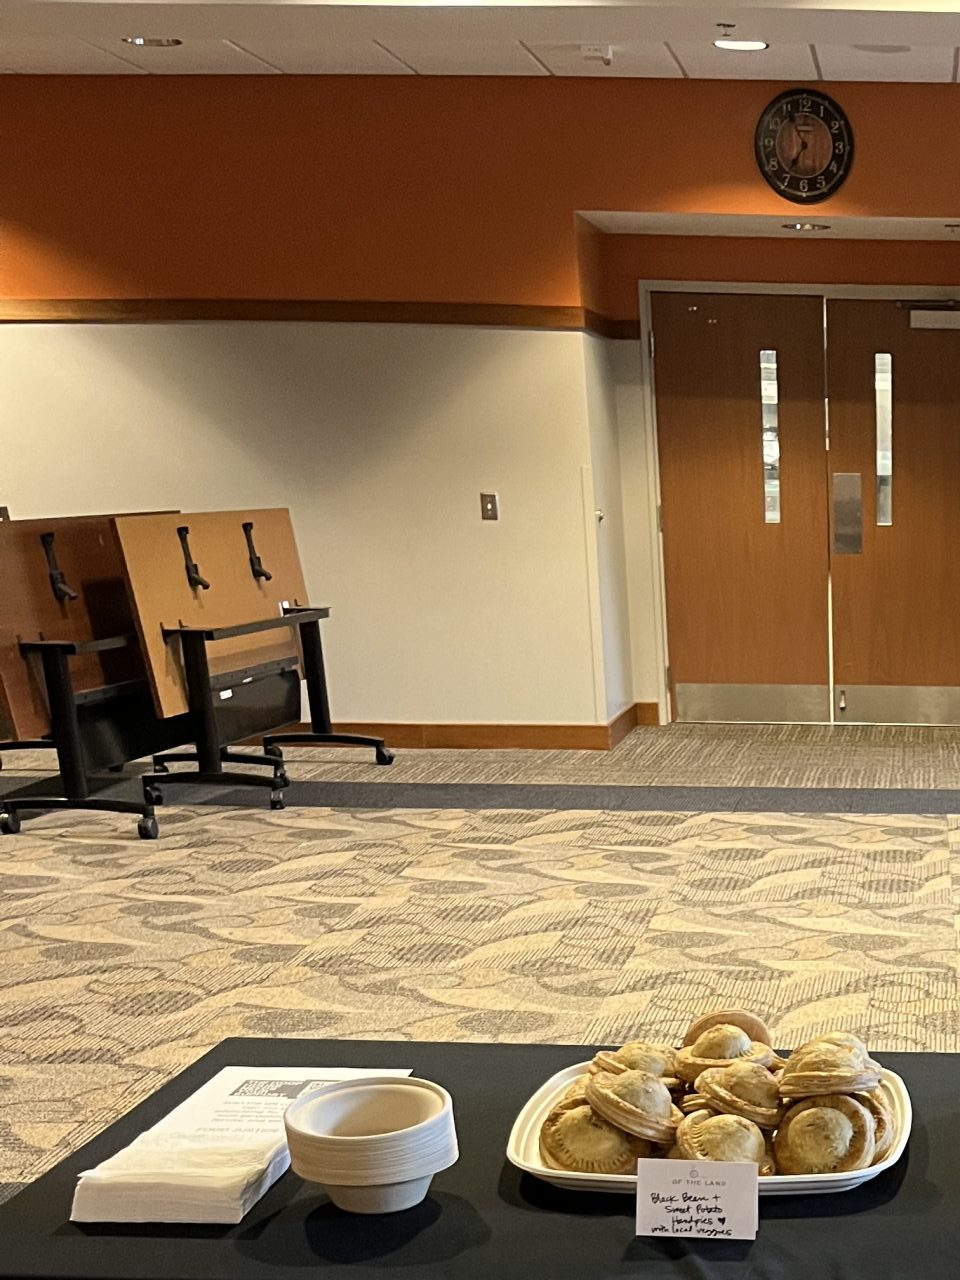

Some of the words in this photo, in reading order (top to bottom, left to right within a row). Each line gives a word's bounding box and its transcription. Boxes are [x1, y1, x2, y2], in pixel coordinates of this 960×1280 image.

[782, 103, 791, 115] 11
[799, 100, 812, 112] 12
[820, 105, 825, 117] 1
[769, 117, 781, 130] 10
[831, 120, 840, 133] 2
[764, 138, 774, 151] 9
[835, 141, 844, 154] 3
[769, 158, 778, 171] 8
[829, 160, 838, 173] 4
[782, 174, 791, 187] 7
[799, 179, 809, 192] 6
[816, 176, 826, 188] 5
[651, 1193, 679, 1204] Black
[682, 1192, 709, 1203] Bean
